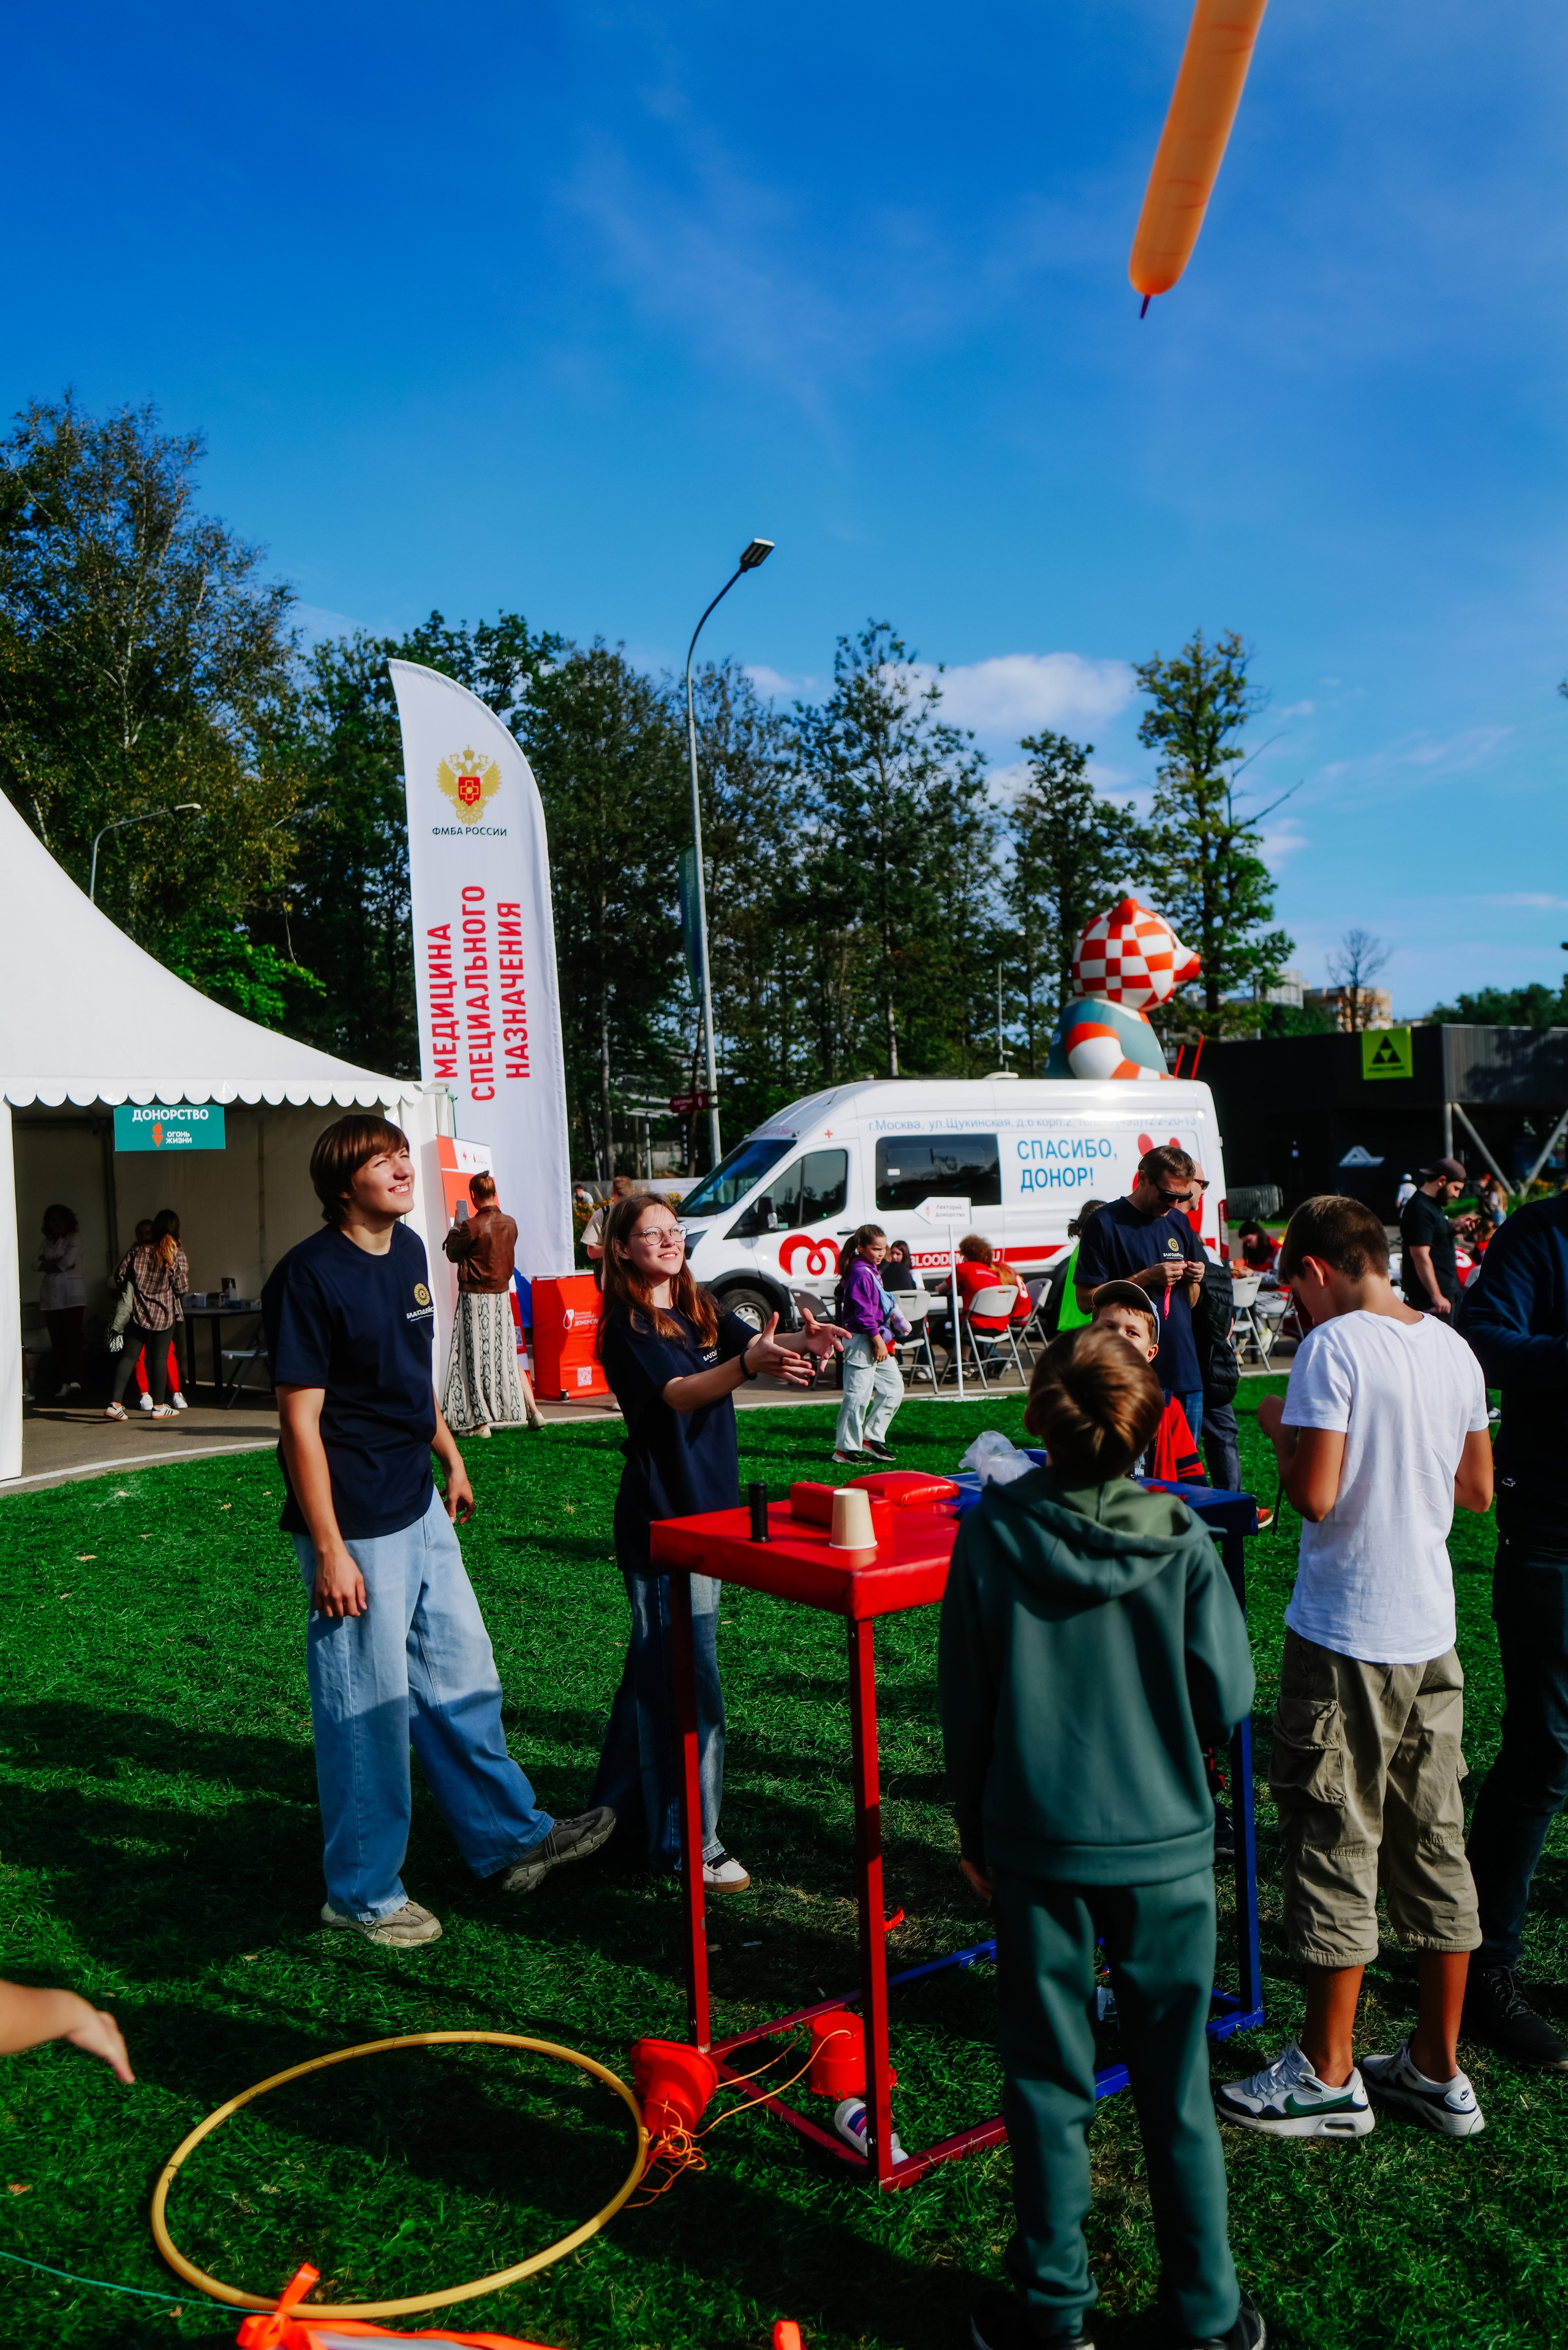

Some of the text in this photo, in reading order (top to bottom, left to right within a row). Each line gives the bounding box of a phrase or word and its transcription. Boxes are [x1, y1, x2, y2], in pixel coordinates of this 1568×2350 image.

[432, 826, 507, 837] ФМБА РОССИИ
[427, 923, 461, 1078] МЕДИЦИНА
[461, 886, 496, 1101] СПЕЦИАЛЬНОГО
[497, 902, 530, 1079] НАЗНАЧЕНИЯ
[132, 1109, 209, 1123] ДОНОРСТВО
[869, 1120, 924, 1131] г.Москва,
[1017, 1138, 1118, 1161] СПАСИБО,
[1020, 1166, 1094, 1193] ДОНОР!
